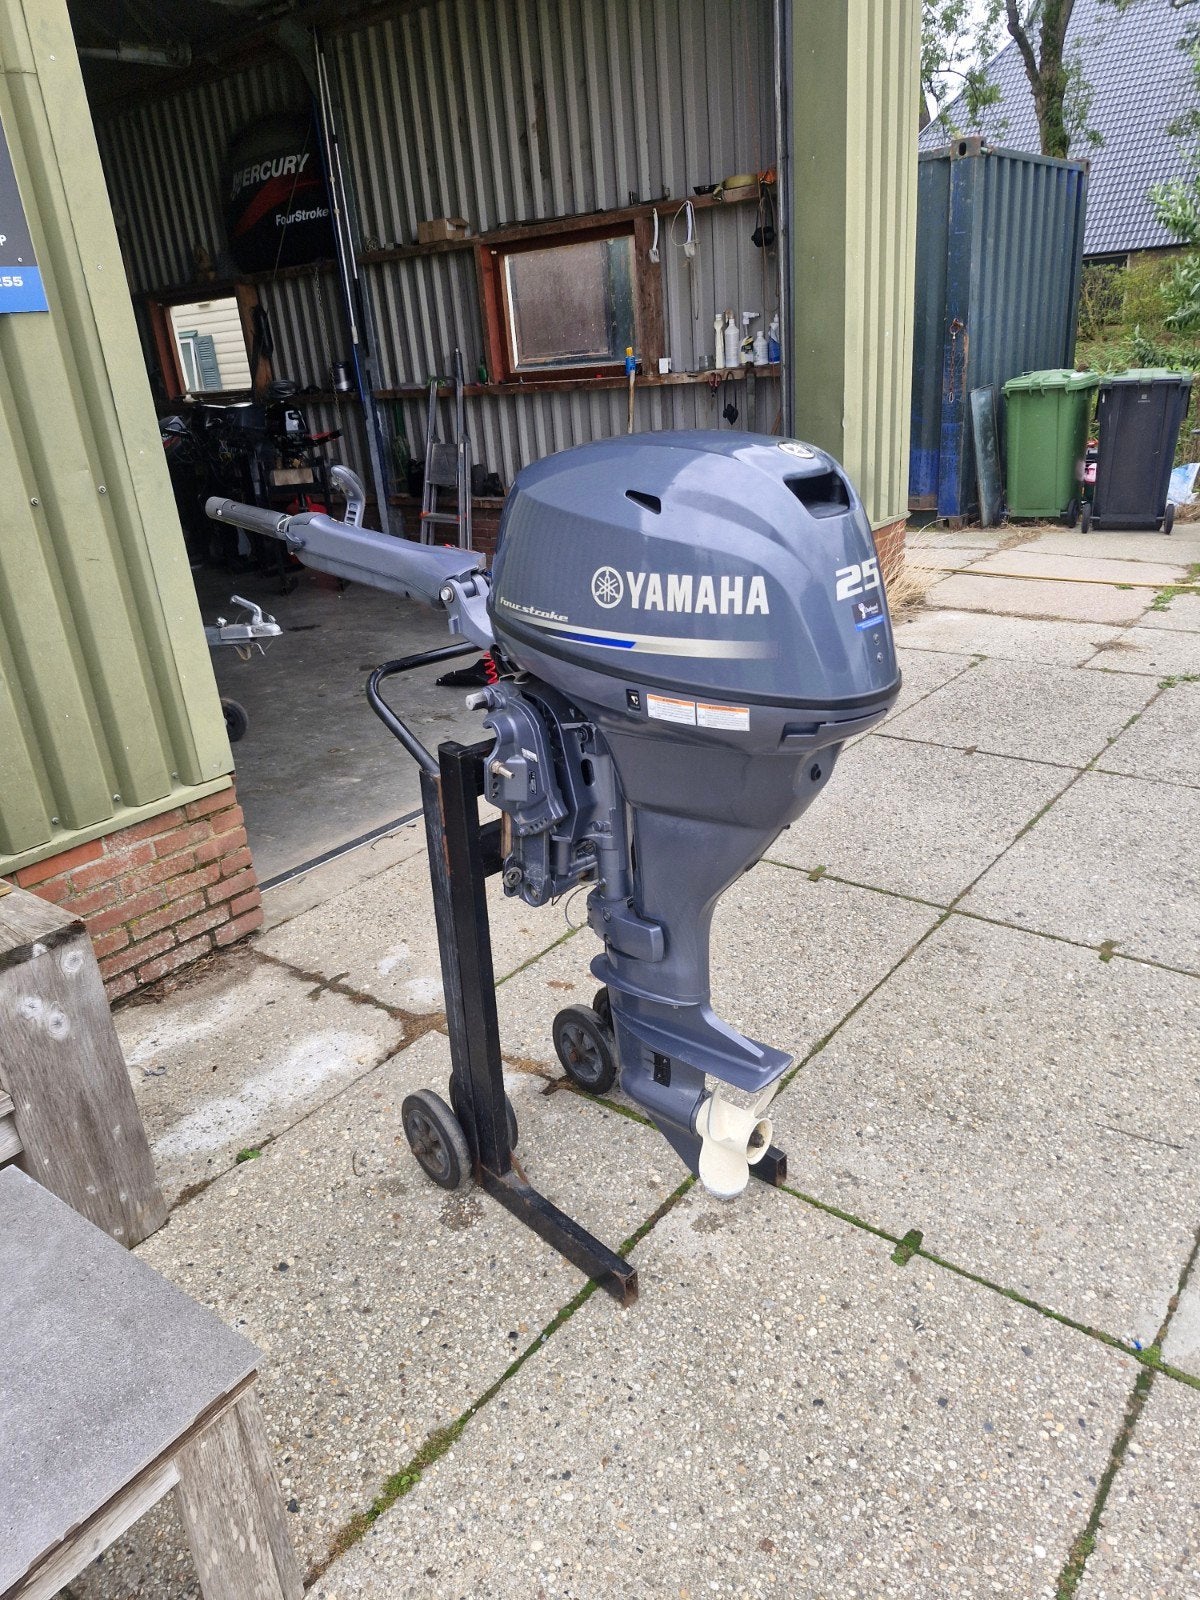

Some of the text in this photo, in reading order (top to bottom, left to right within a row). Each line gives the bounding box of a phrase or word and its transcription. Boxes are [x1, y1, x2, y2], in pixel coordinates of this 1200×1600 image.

[231, 153, 310, 193] MERCURY
[275, 207, 329, 226] FourStroke
[0, 276, 24, 287] 55
[626, 571, 770, 615] YAMAHA
[835, 557, 880, 601] 25
